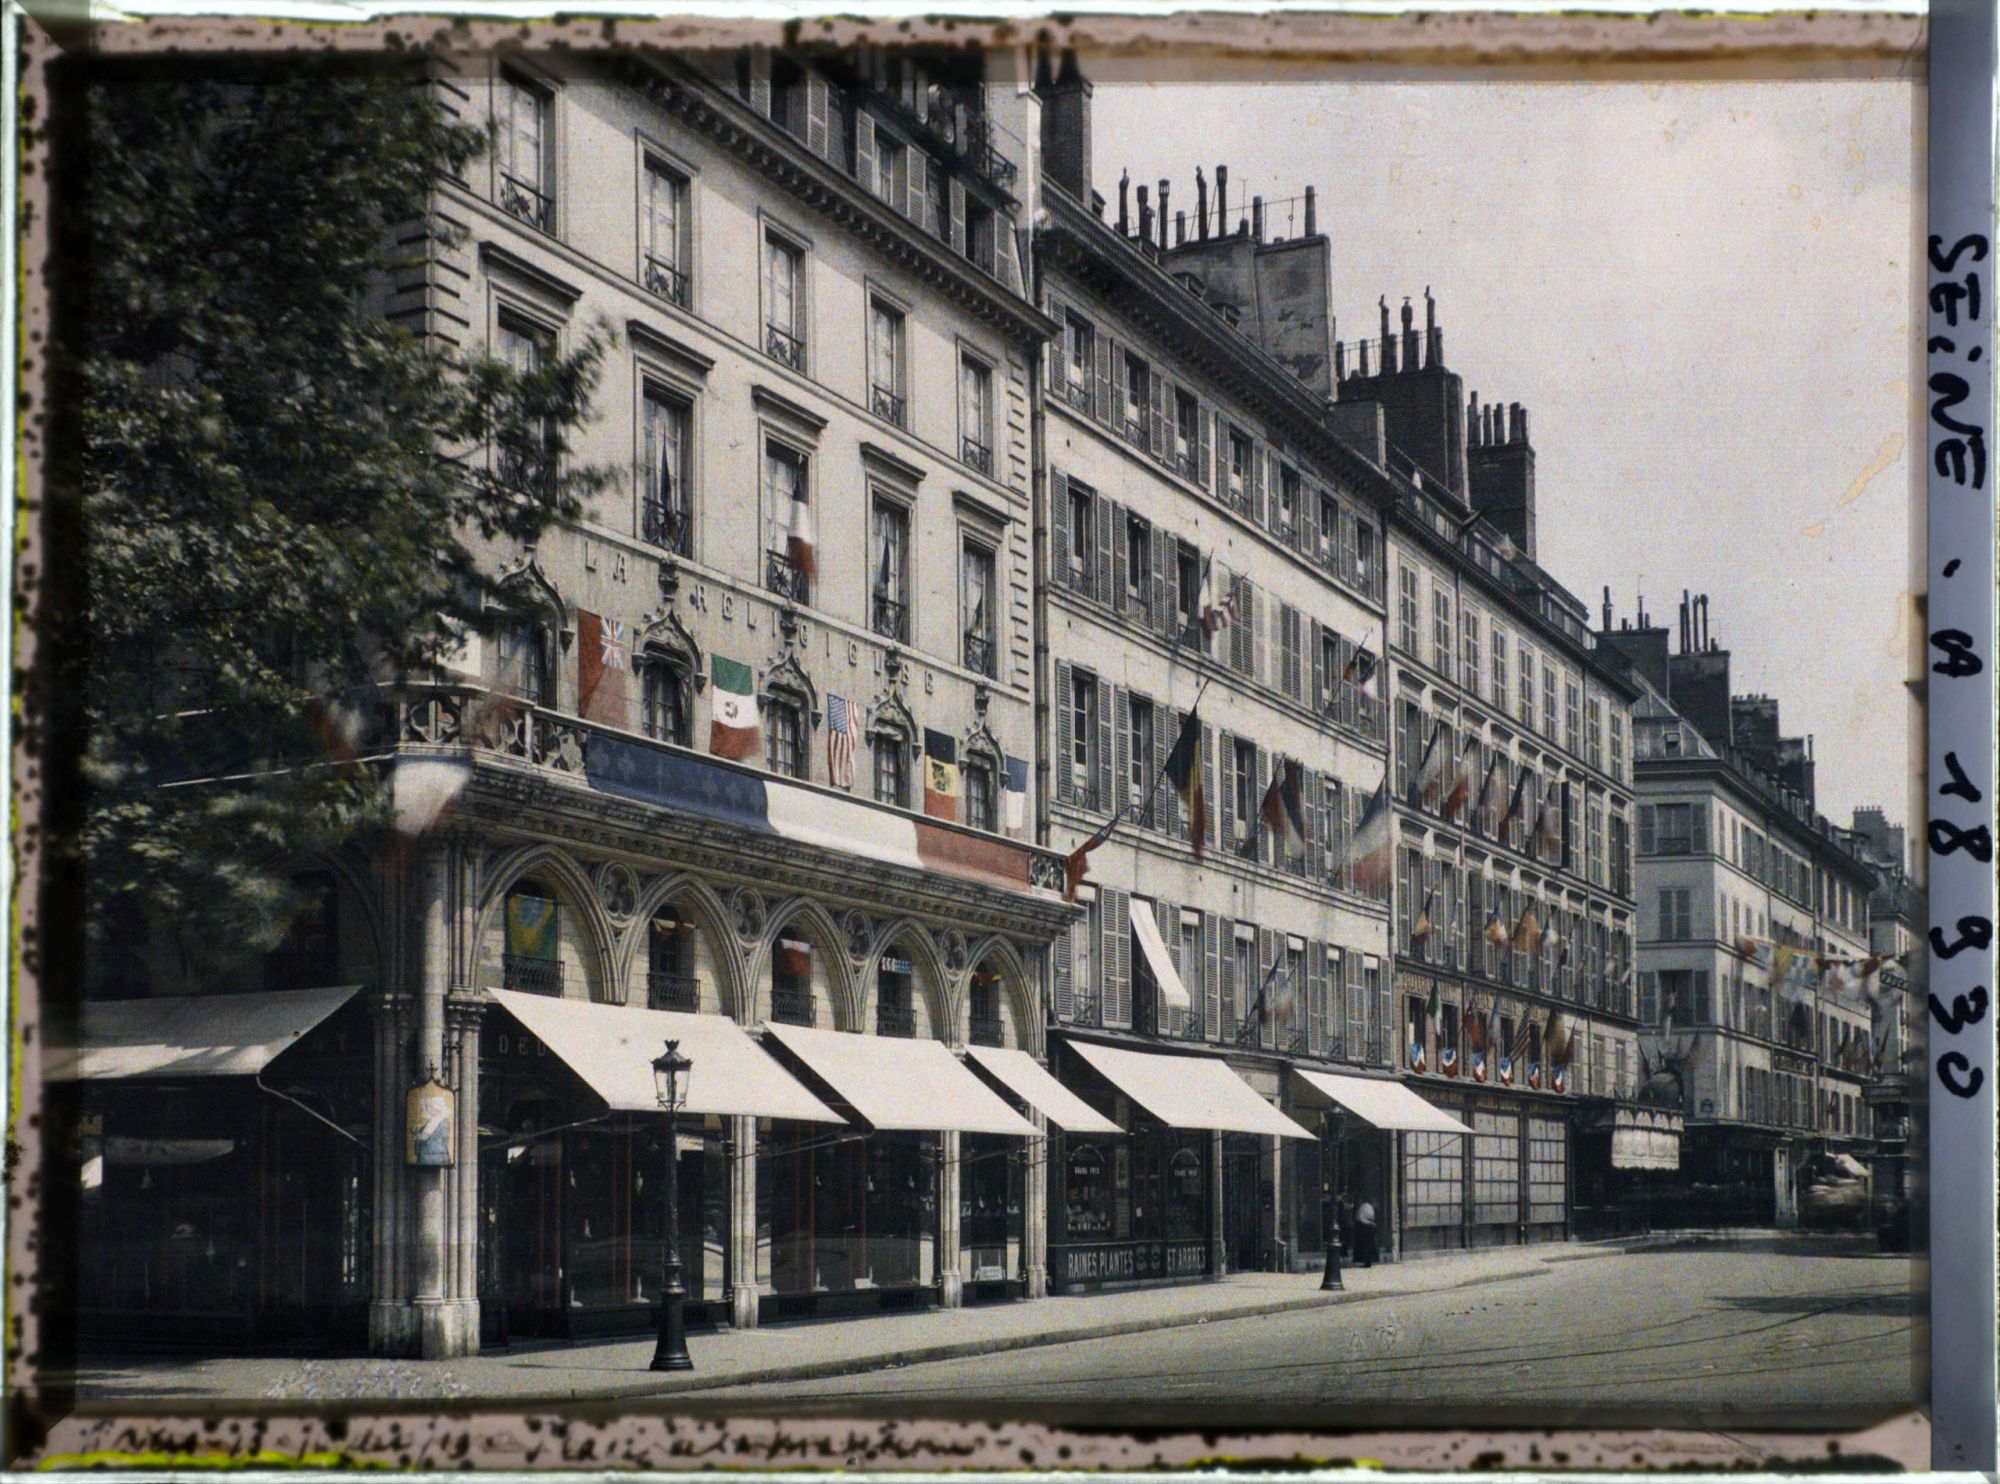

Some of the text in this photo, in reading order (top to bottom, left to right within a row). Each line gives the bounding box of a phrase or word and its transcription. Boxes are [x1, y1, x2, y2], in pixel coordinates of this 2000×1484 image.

[585, 541, 627, 584] LA
[1930, 628, 1983, 677] A
[1167, 1247, 1176, 1271] ET
